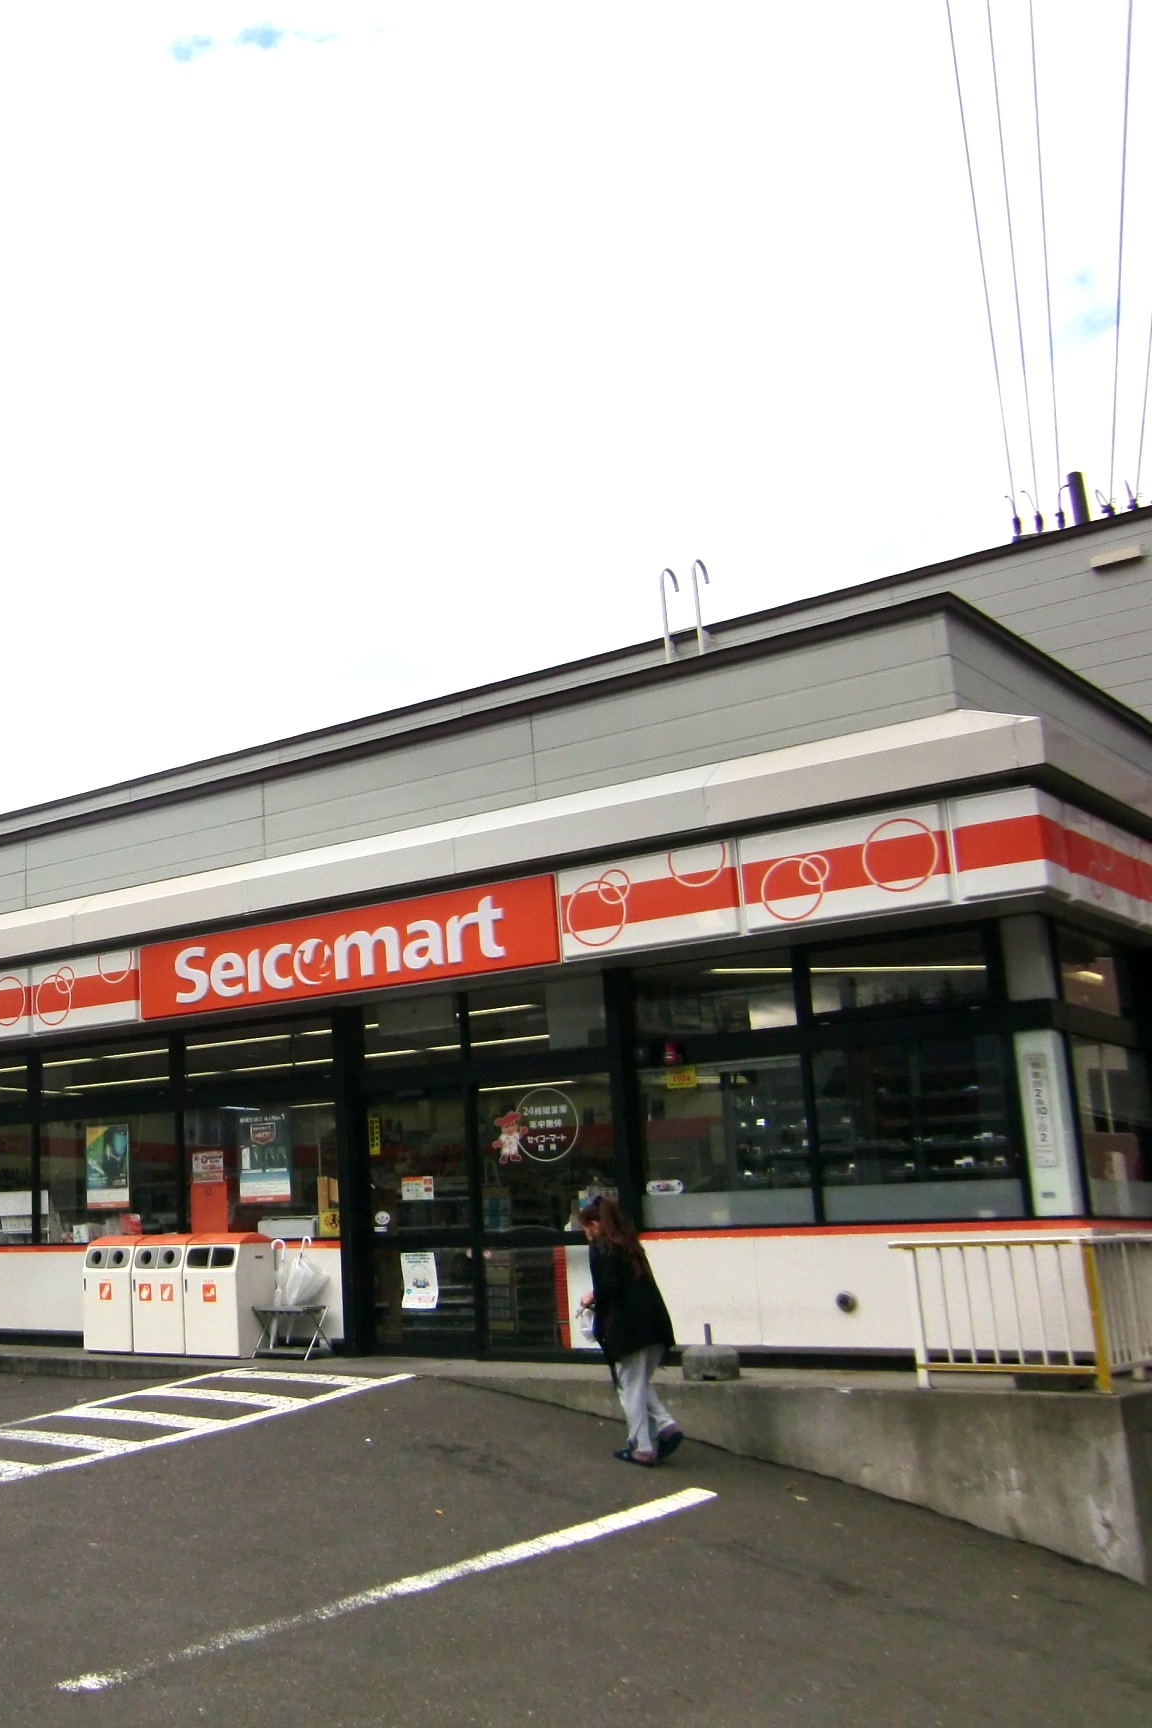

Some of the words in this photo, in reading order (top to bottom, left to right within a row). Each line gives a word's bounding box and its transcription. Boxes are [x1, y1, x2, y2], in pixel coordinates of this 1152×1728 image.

[174, 895, 506, 1003] Seicomart
[527, 1133, 567, 1144] セイコーマート
